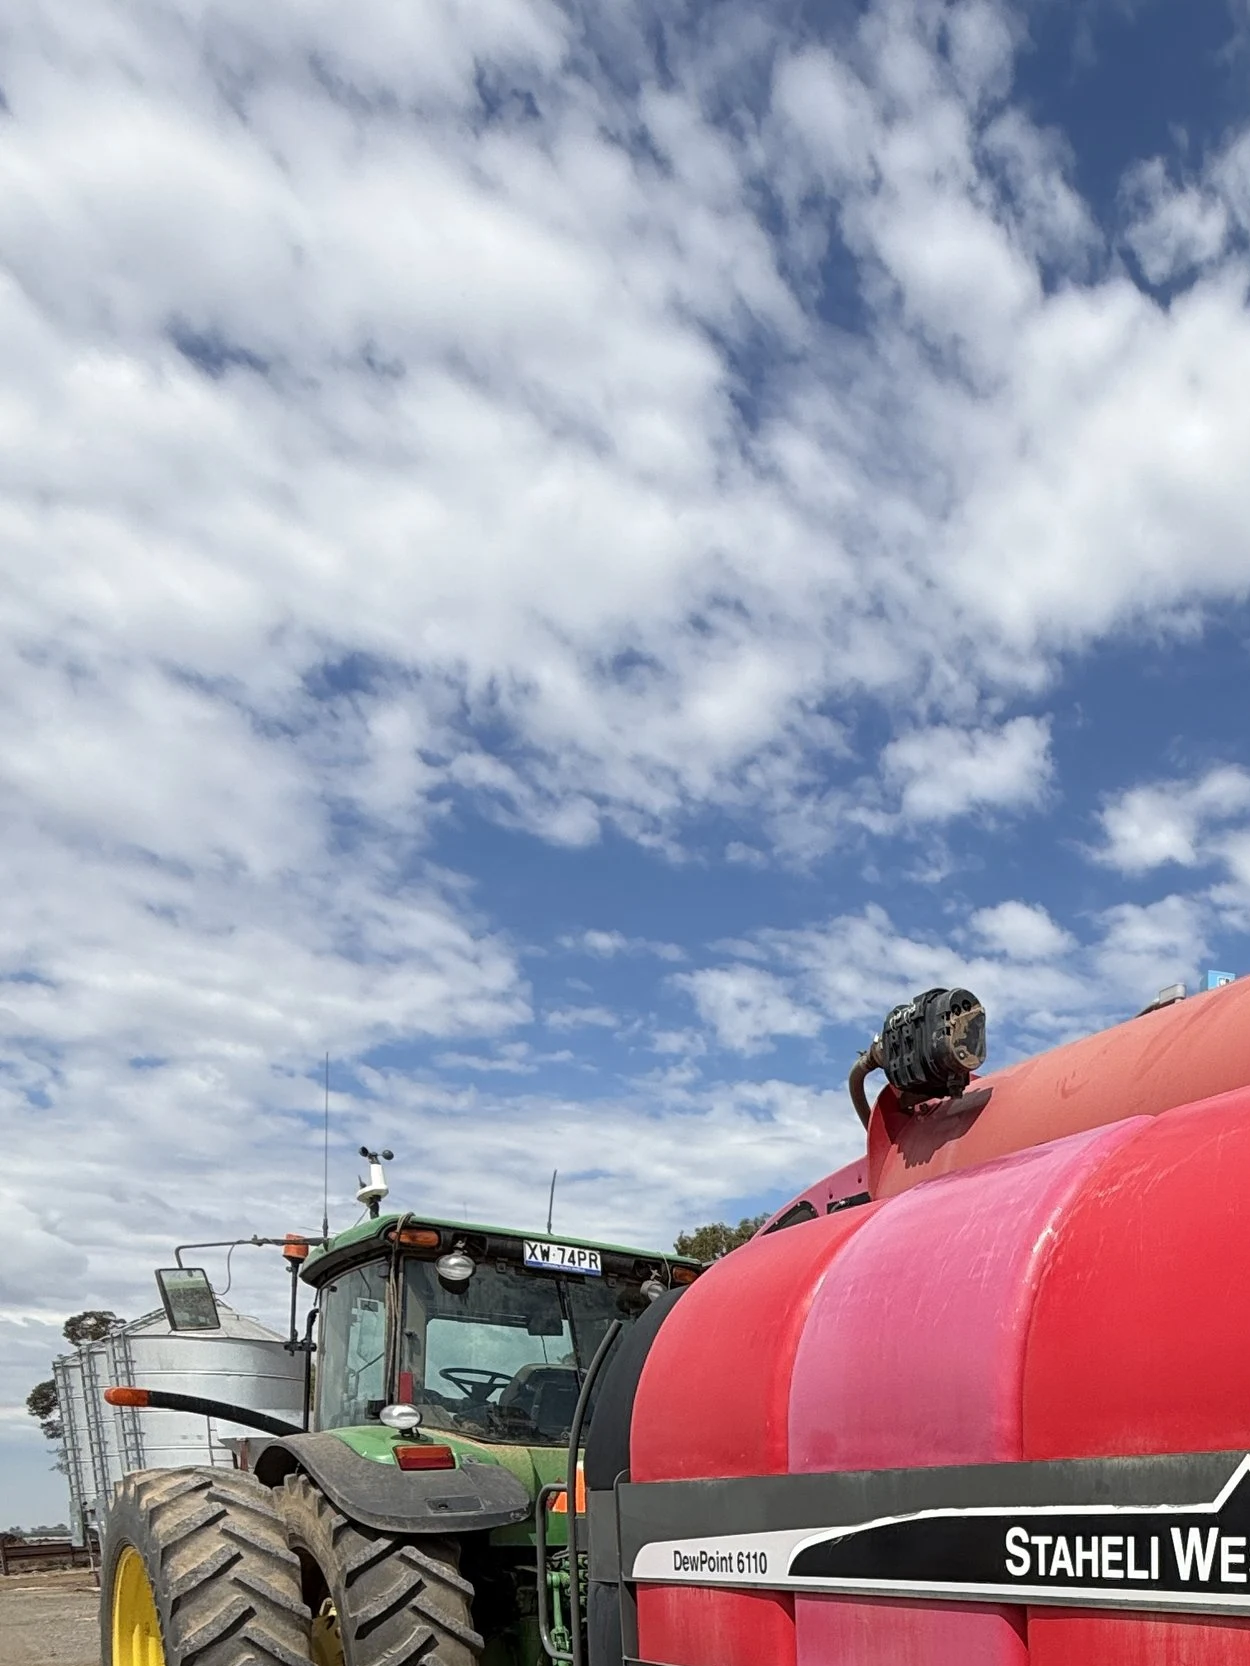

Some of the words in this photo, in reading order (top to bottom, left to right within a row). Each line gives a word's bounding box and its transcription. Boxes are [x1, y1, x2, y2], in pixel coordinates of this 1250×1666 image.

[673, 1550, 733, 1573] DewPoint
[737, 1551, 768, 1574] 6110
[1004, 1526, 1160, 1580] STAHELI
